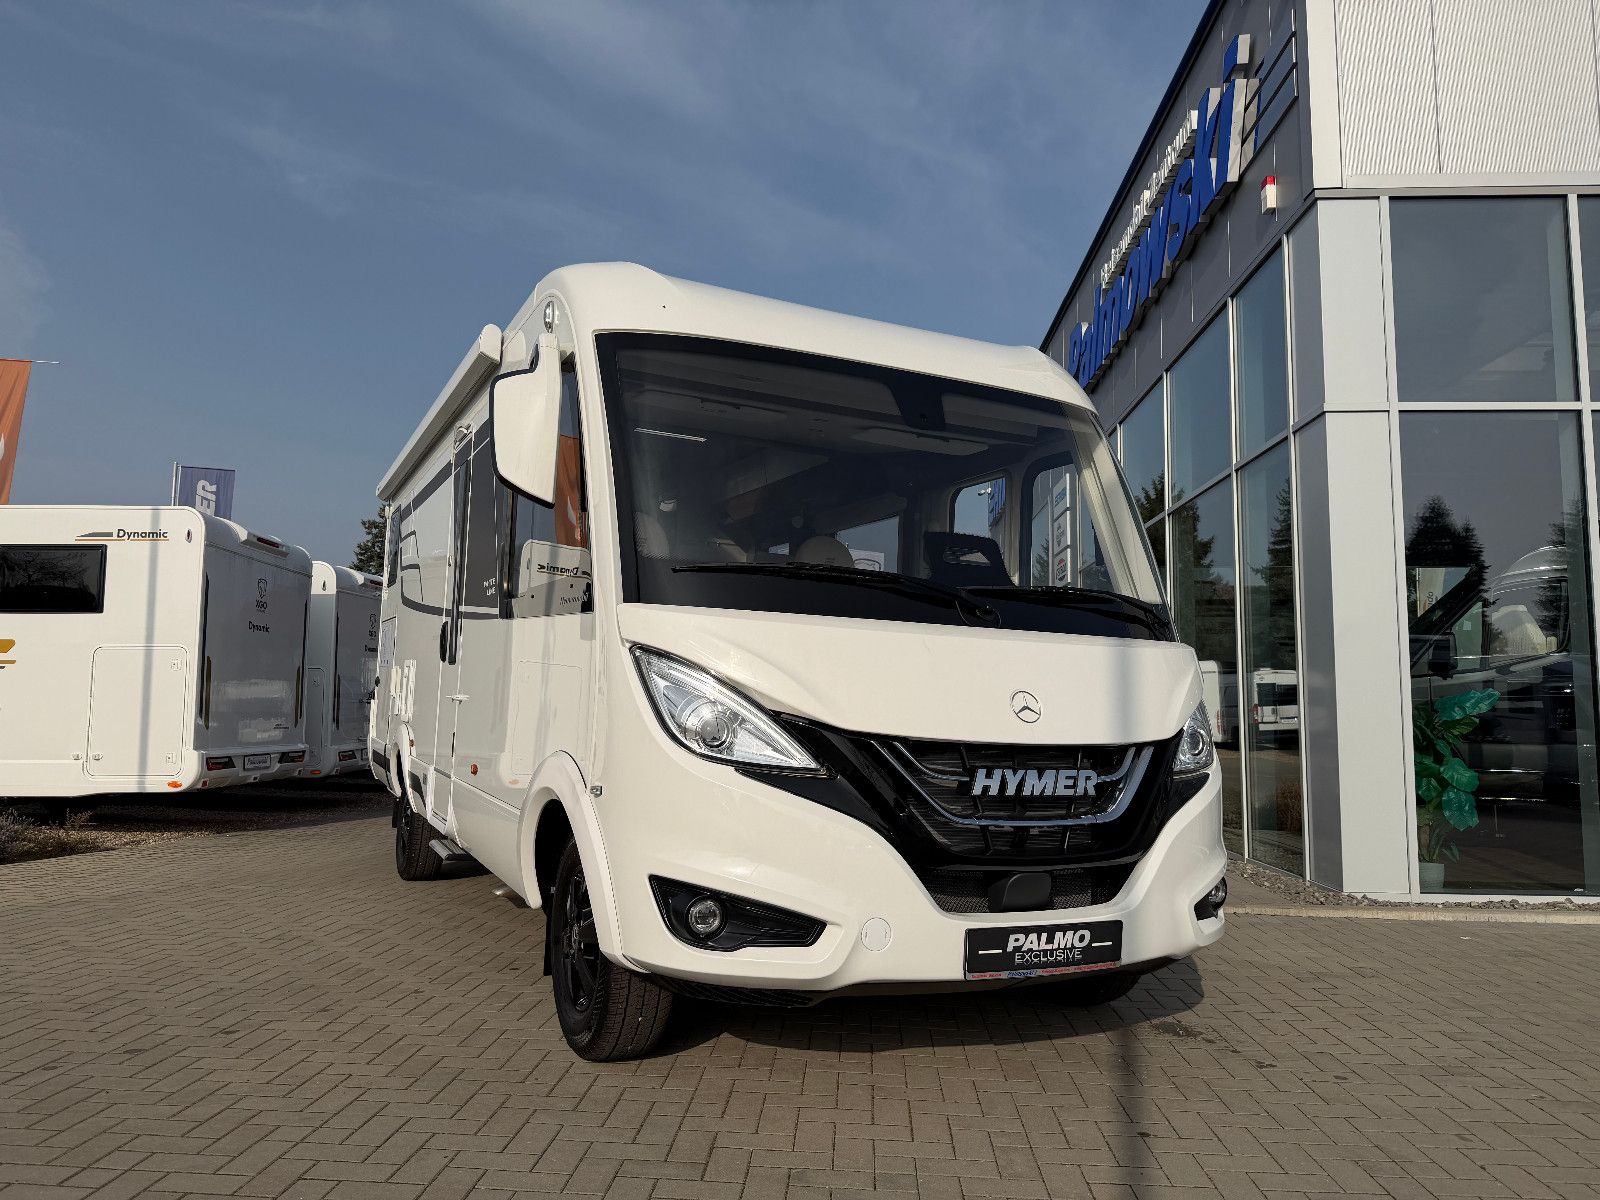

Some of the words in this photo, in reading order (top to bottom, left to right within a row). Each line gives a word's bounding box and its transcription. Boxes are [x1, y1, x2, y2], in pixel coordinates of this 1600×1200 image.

[117, 528, 169, 541] Dynamic
[971, 768, 1099, 796] HYMER
[1006, 929, 1091, 952] PALMO
[1014, 948, 1083, 962] EXCLUSIVE
